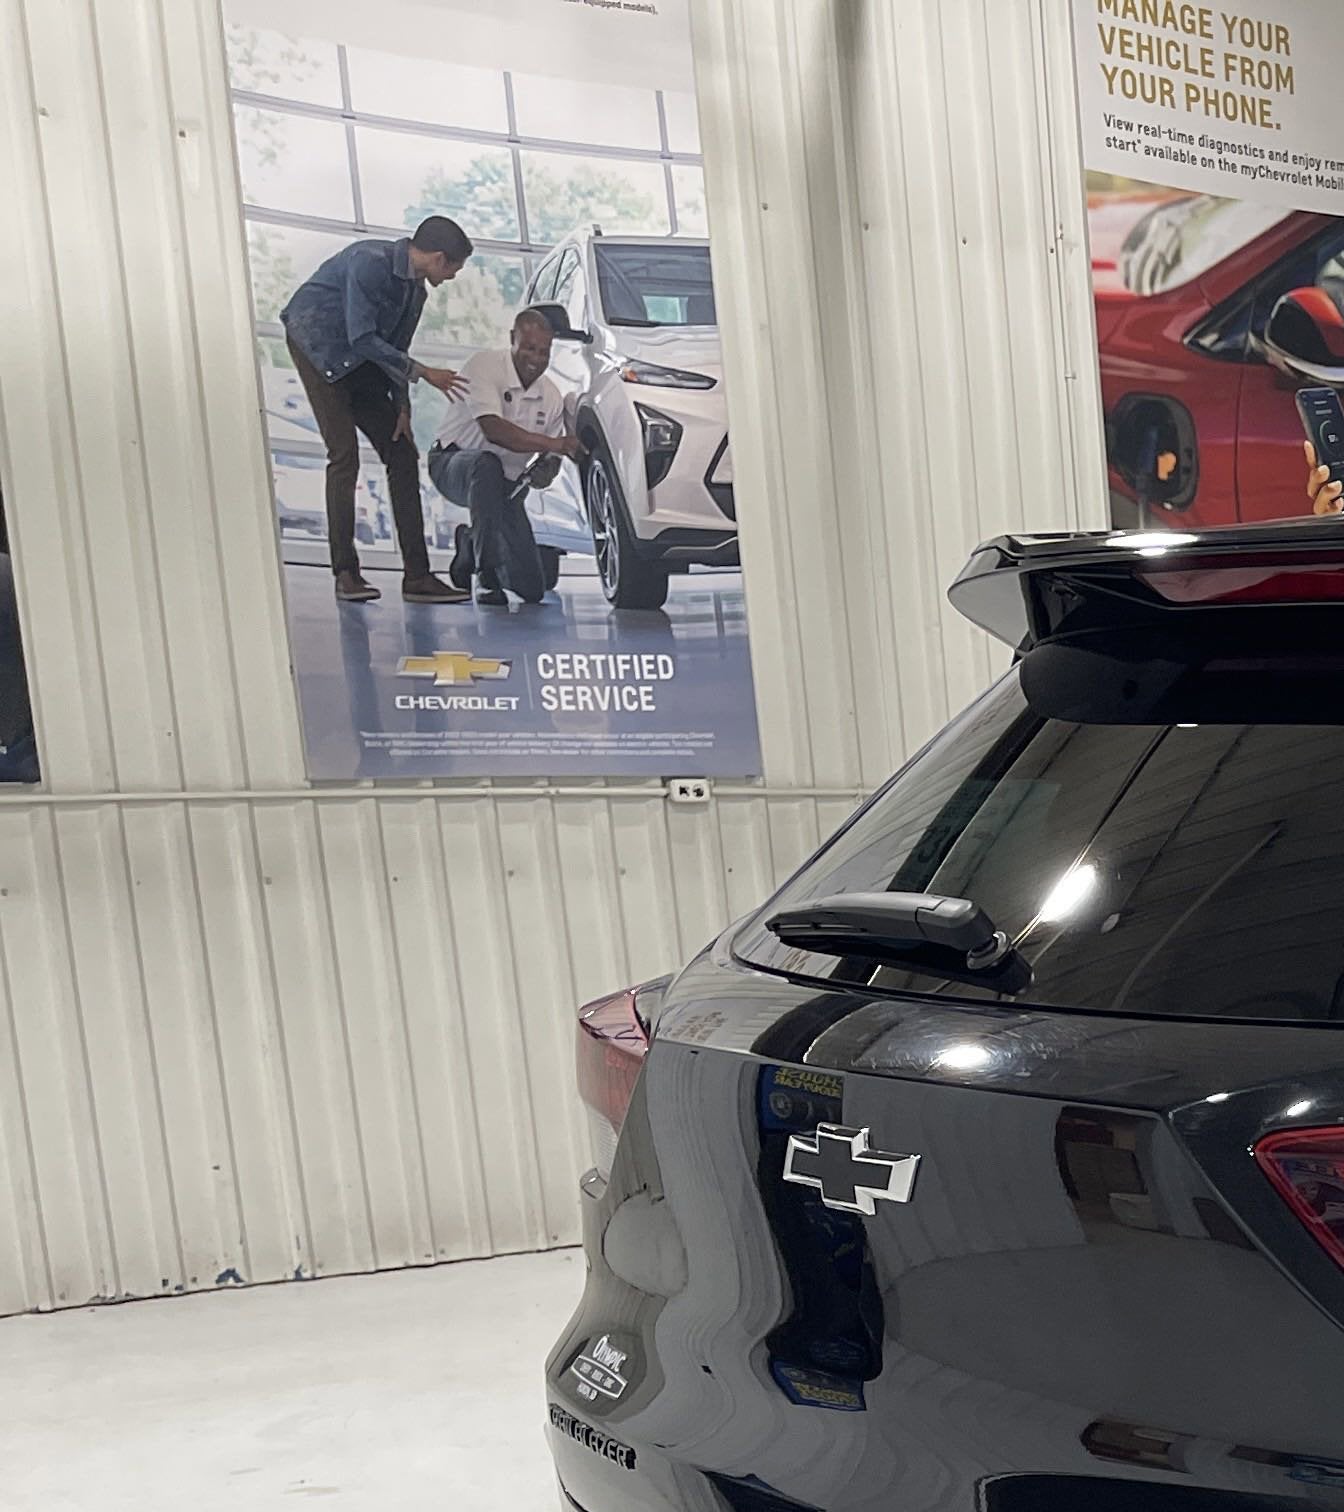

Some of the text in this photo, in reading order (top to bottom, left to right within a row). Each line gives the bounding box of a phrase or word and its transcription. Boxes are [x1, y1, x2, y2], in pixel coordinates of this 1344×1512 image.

[1221, 13, 1291, 56] YOUR
[1097, 23, 1295, 95] VEHICLE FROM
[1100, 63, 1282, 130] YOUR PHONE.
[1103, 112, 1134, 132] View
[1137, 123, 1195, 146] real-time
[1198, 134, 1265, 159] diagnostics
[1268, 149, 1289, 163] and
[1292, 152, 1322, 172] enjoy
[1144, 143, 1197, 165] available
[1201, 157, 1215, 169] on
[1218, 158, 1237, 174] the
[1241, 164, 1312, 187] myChevrolet
[537, 653, 675, 680] CERTIFIED
[395, 696, 519, 711] CHEVROLET
[541, 685, 656, 712] SERVICE
